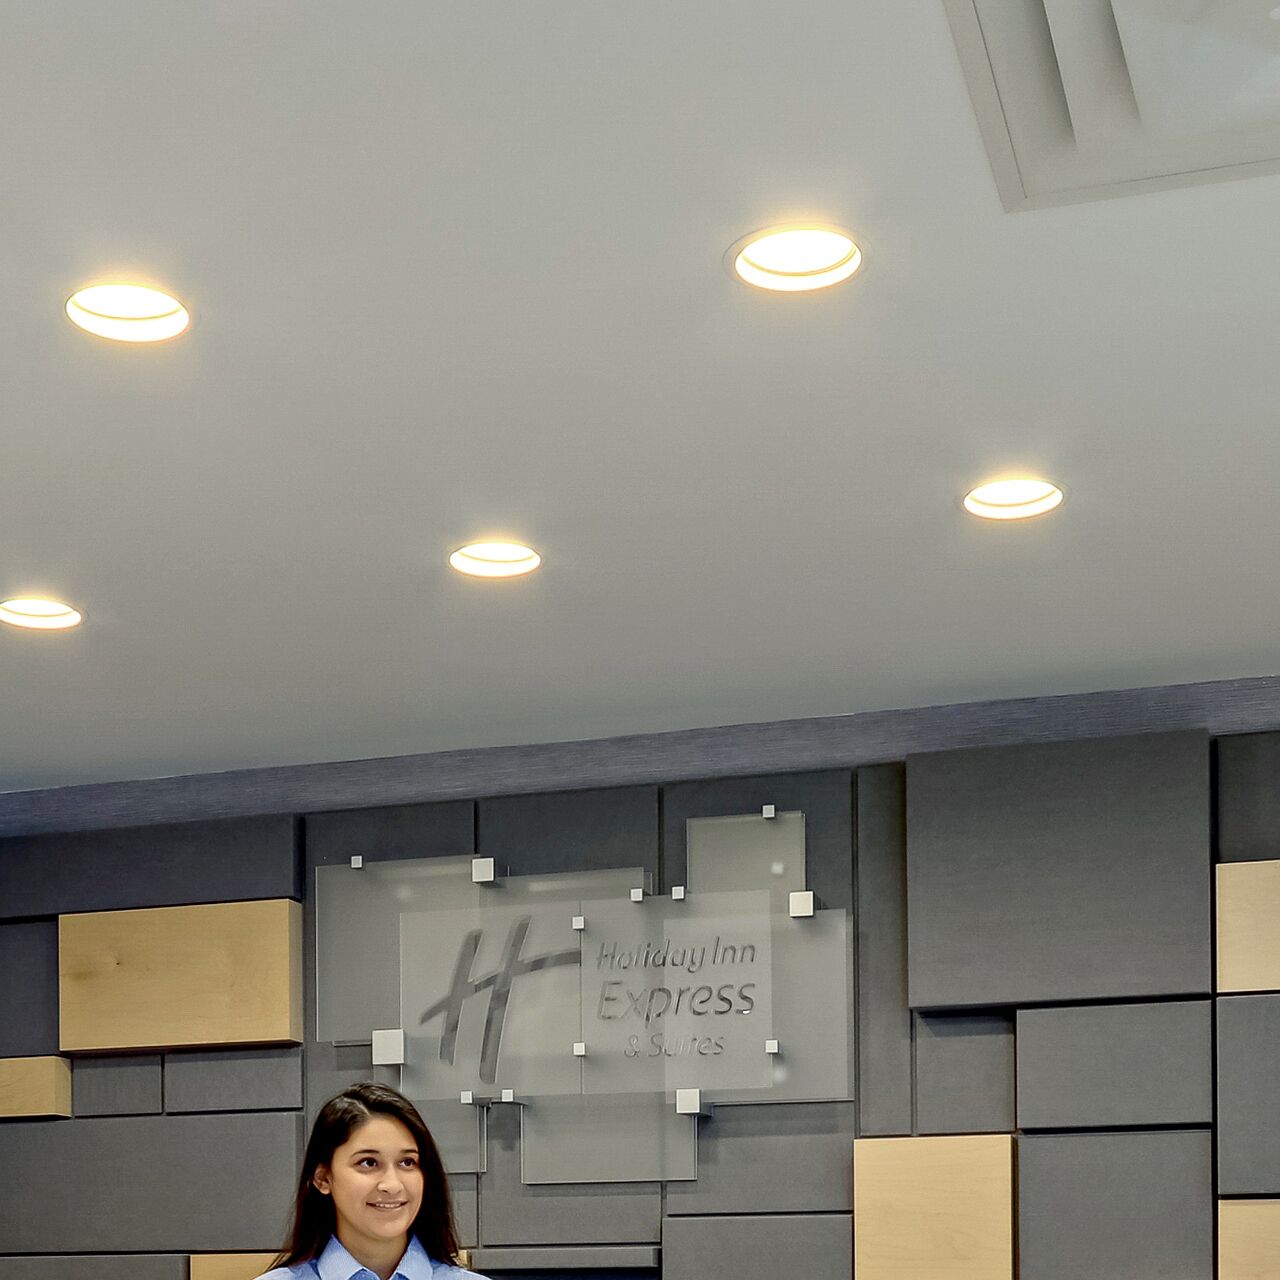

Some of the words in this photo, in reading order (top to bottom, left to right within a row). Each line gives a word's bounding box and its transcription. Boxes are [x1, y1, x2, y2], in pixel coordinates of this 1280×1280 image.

[597, 937, 705, 973] Holiday
[712, 935, 756, 965] Inn
[597, 981, 756, 1029] Express
[624, 1034, 640, 1058] &
